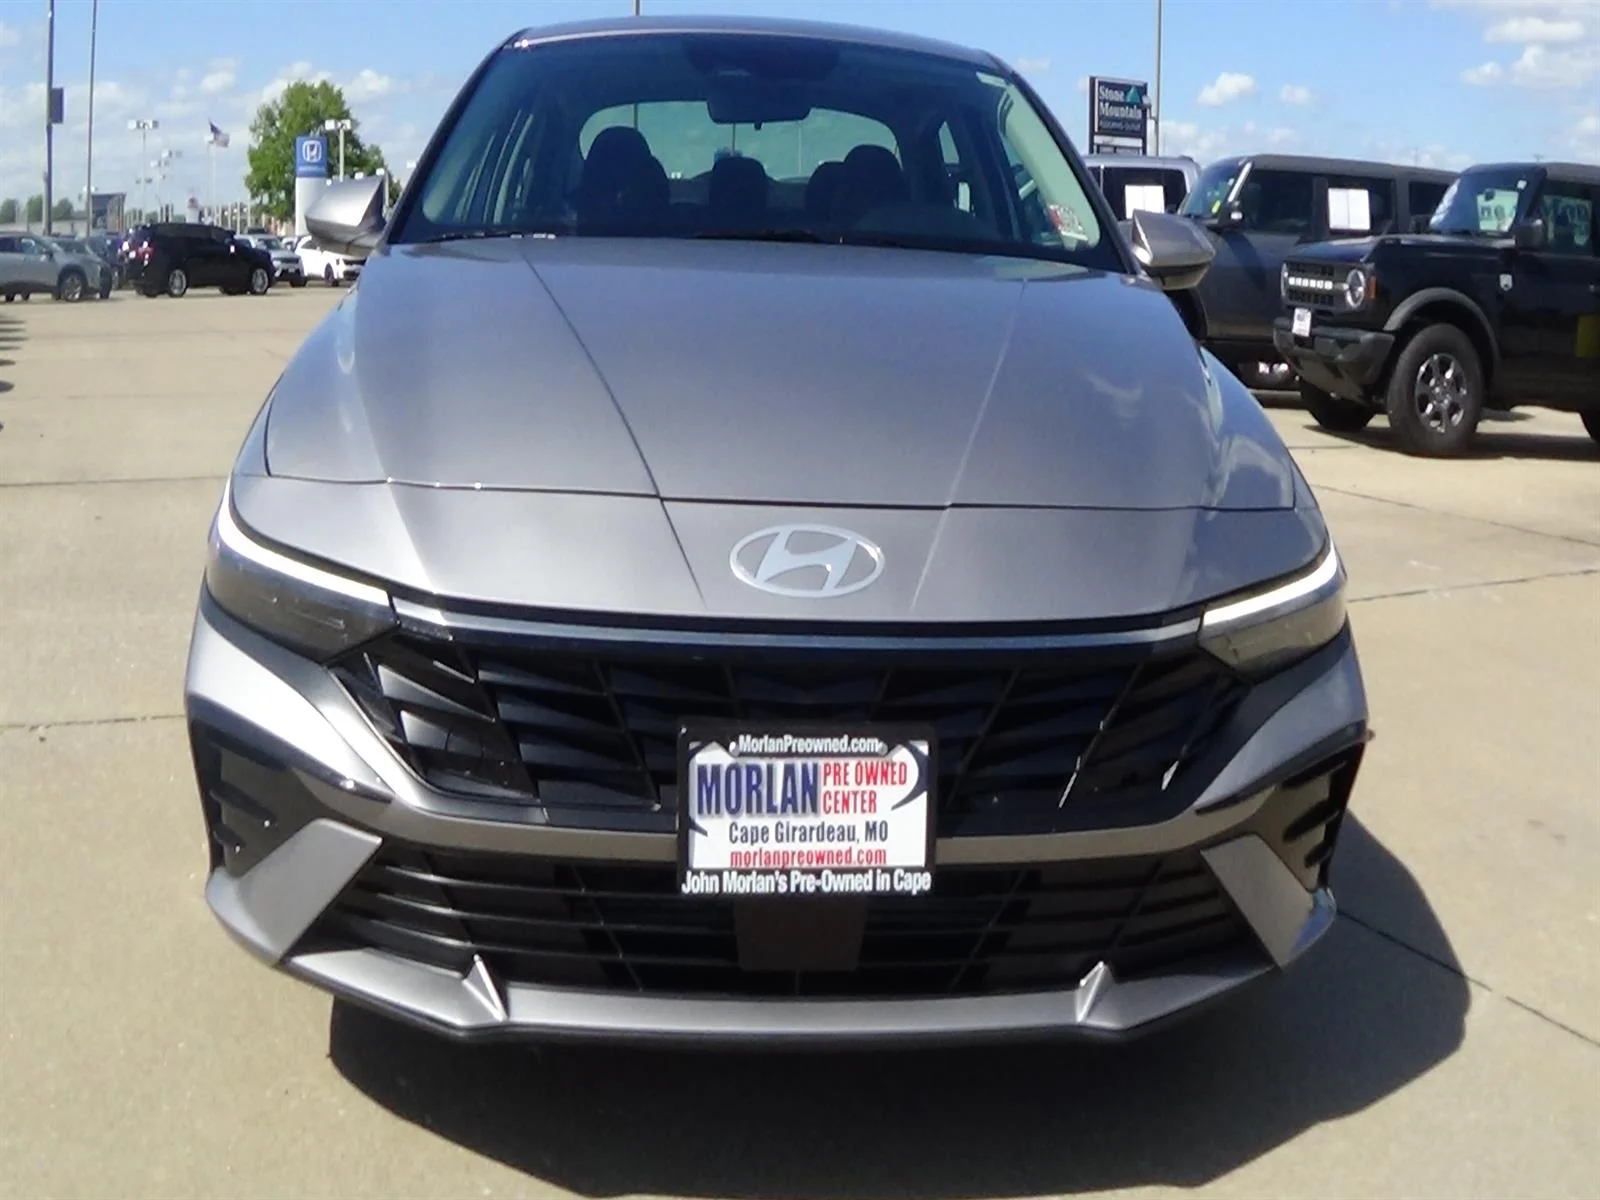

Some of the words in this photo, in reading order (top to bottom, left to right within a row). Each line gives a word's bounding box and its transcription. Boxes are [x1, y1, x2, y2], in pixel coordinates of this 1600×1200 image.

[738, 734, 879, 753] MorlanPreowned.com
[823, 762, 850, 786] PRE
[854, 761, 908, 786] OWNED
[697, 763, 819, 815] MORLAN
[823, 790, 877, 815] CENTER
[728, 821, 770, 846] Cape
[775, 820, 860, 844] Girardeau,
[864, 820, 889, 843] MO
[730, 847, 887, 868] morlanpreowned.com
[681, 870, 720, 894] John
[722, 870, 788, 894] Morlan's
[790, 869, 873, 894] Pre-Owned
[876, 868, 891, 892] in
[893, 868, 932, 896] Cape
